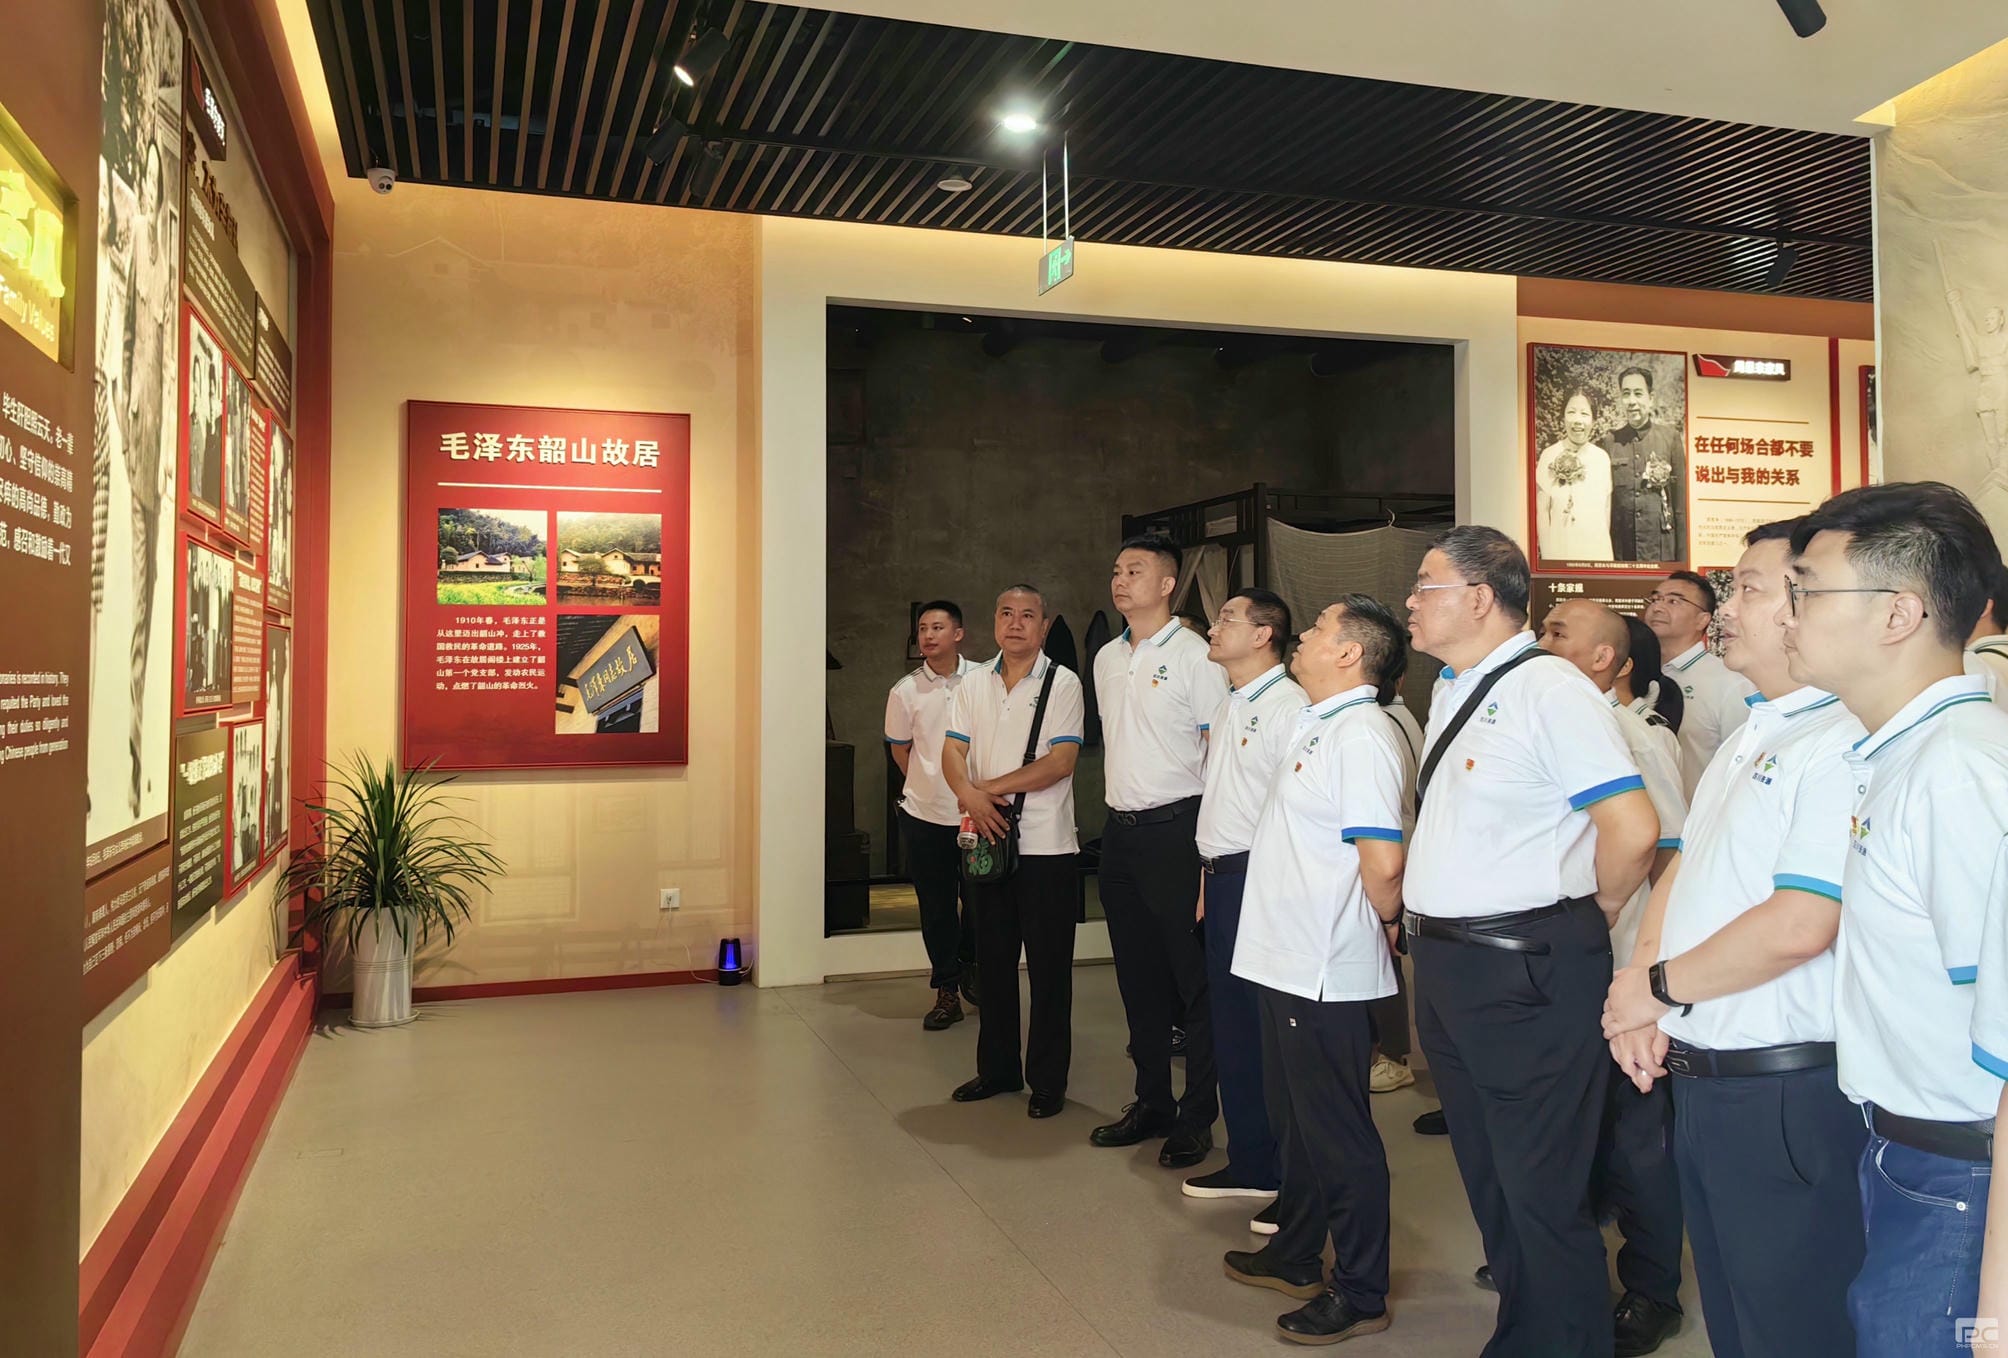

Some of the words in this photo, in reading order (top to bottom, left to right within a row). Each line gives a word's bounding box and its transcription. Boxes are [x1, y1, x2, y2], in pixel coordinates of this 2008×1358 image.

[0, 274, 27, 324] amily
[439, 432, 661, 467] 毛泽东韶山故居
[1694, 435, 1814, 457] 在任何场合都不要
[1695, 465, 1800, 486] 说出与我的关系
